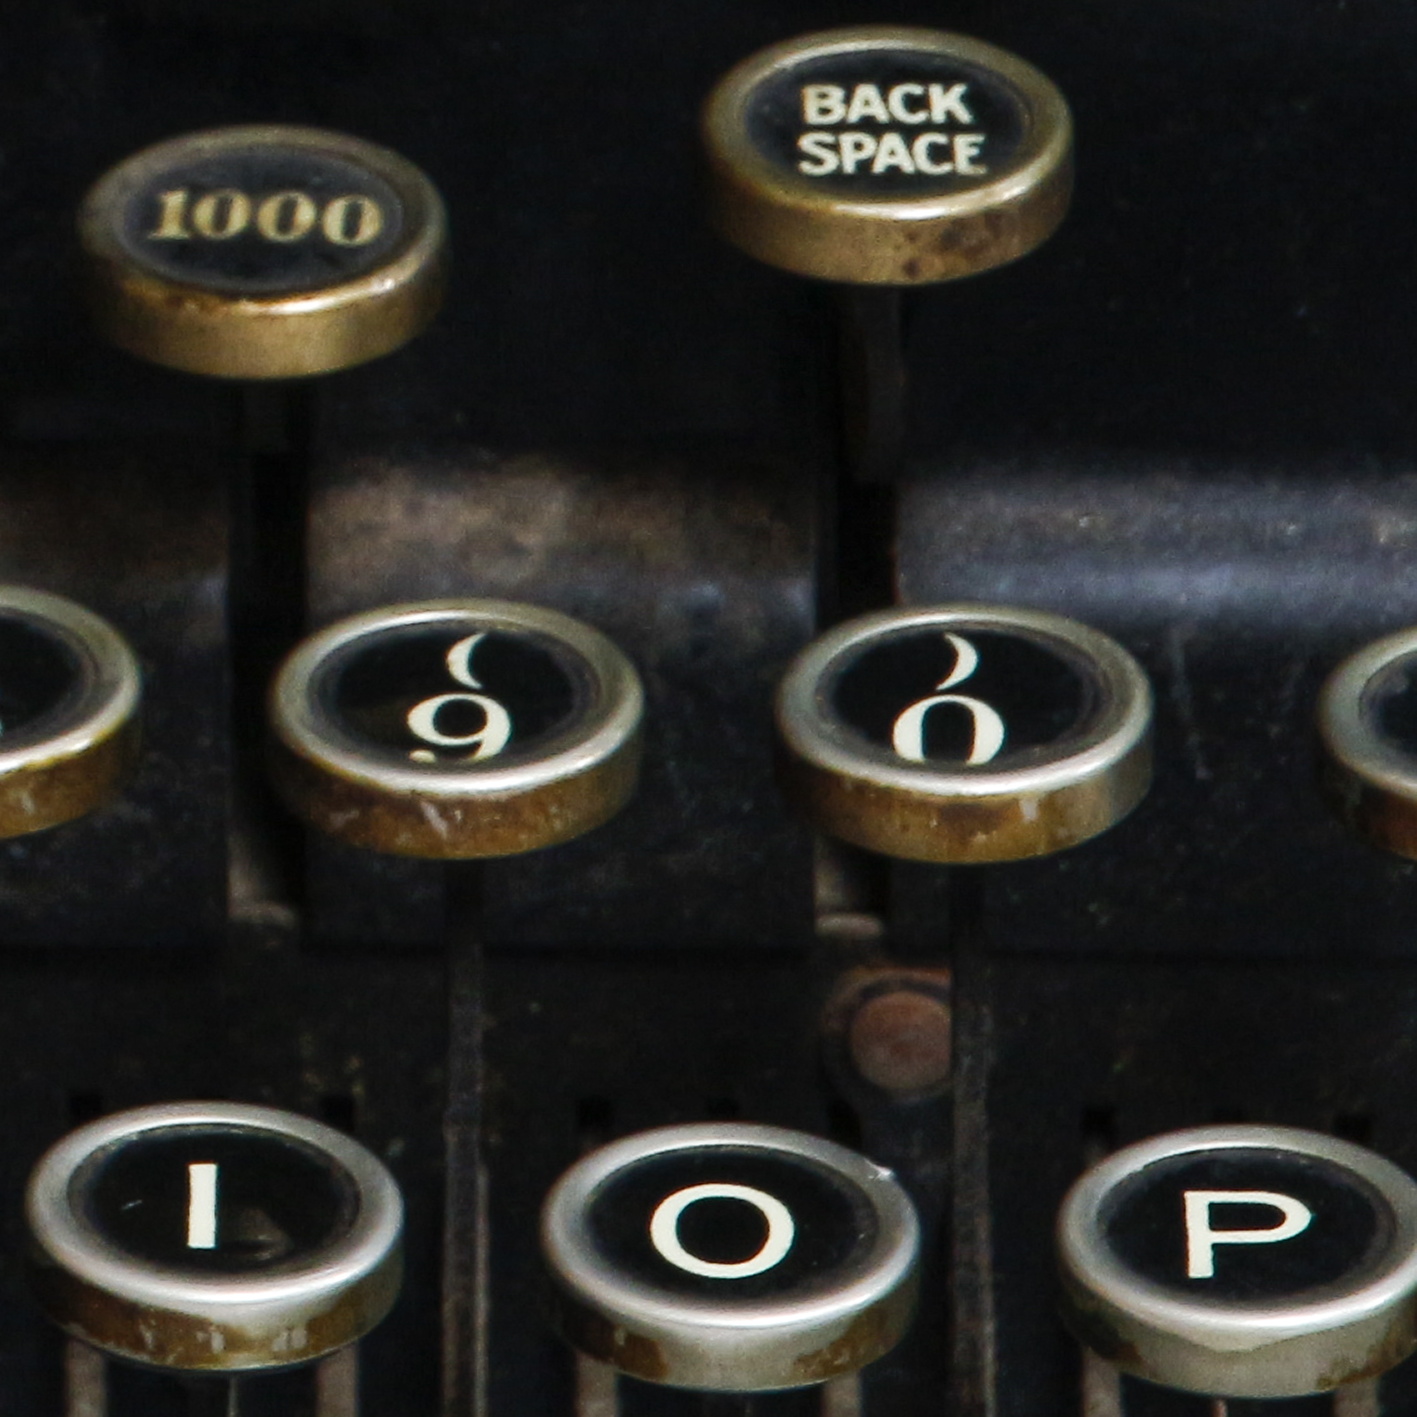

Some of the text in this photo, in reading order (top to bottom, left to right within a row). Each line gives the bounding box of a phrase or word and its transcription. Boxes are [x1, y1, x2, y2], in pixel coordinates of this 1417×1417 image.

[804, 84, 972, 124] BACK
[799, 133, 985, 175] SPACE
[149, 188, 384, 248] 1000
[408, 694, 510, 762] 9
[188, 1164, 217, 1248] I
[651, 1184, 794, 1278] O
[1184, 1191, 1311, 1278] P
